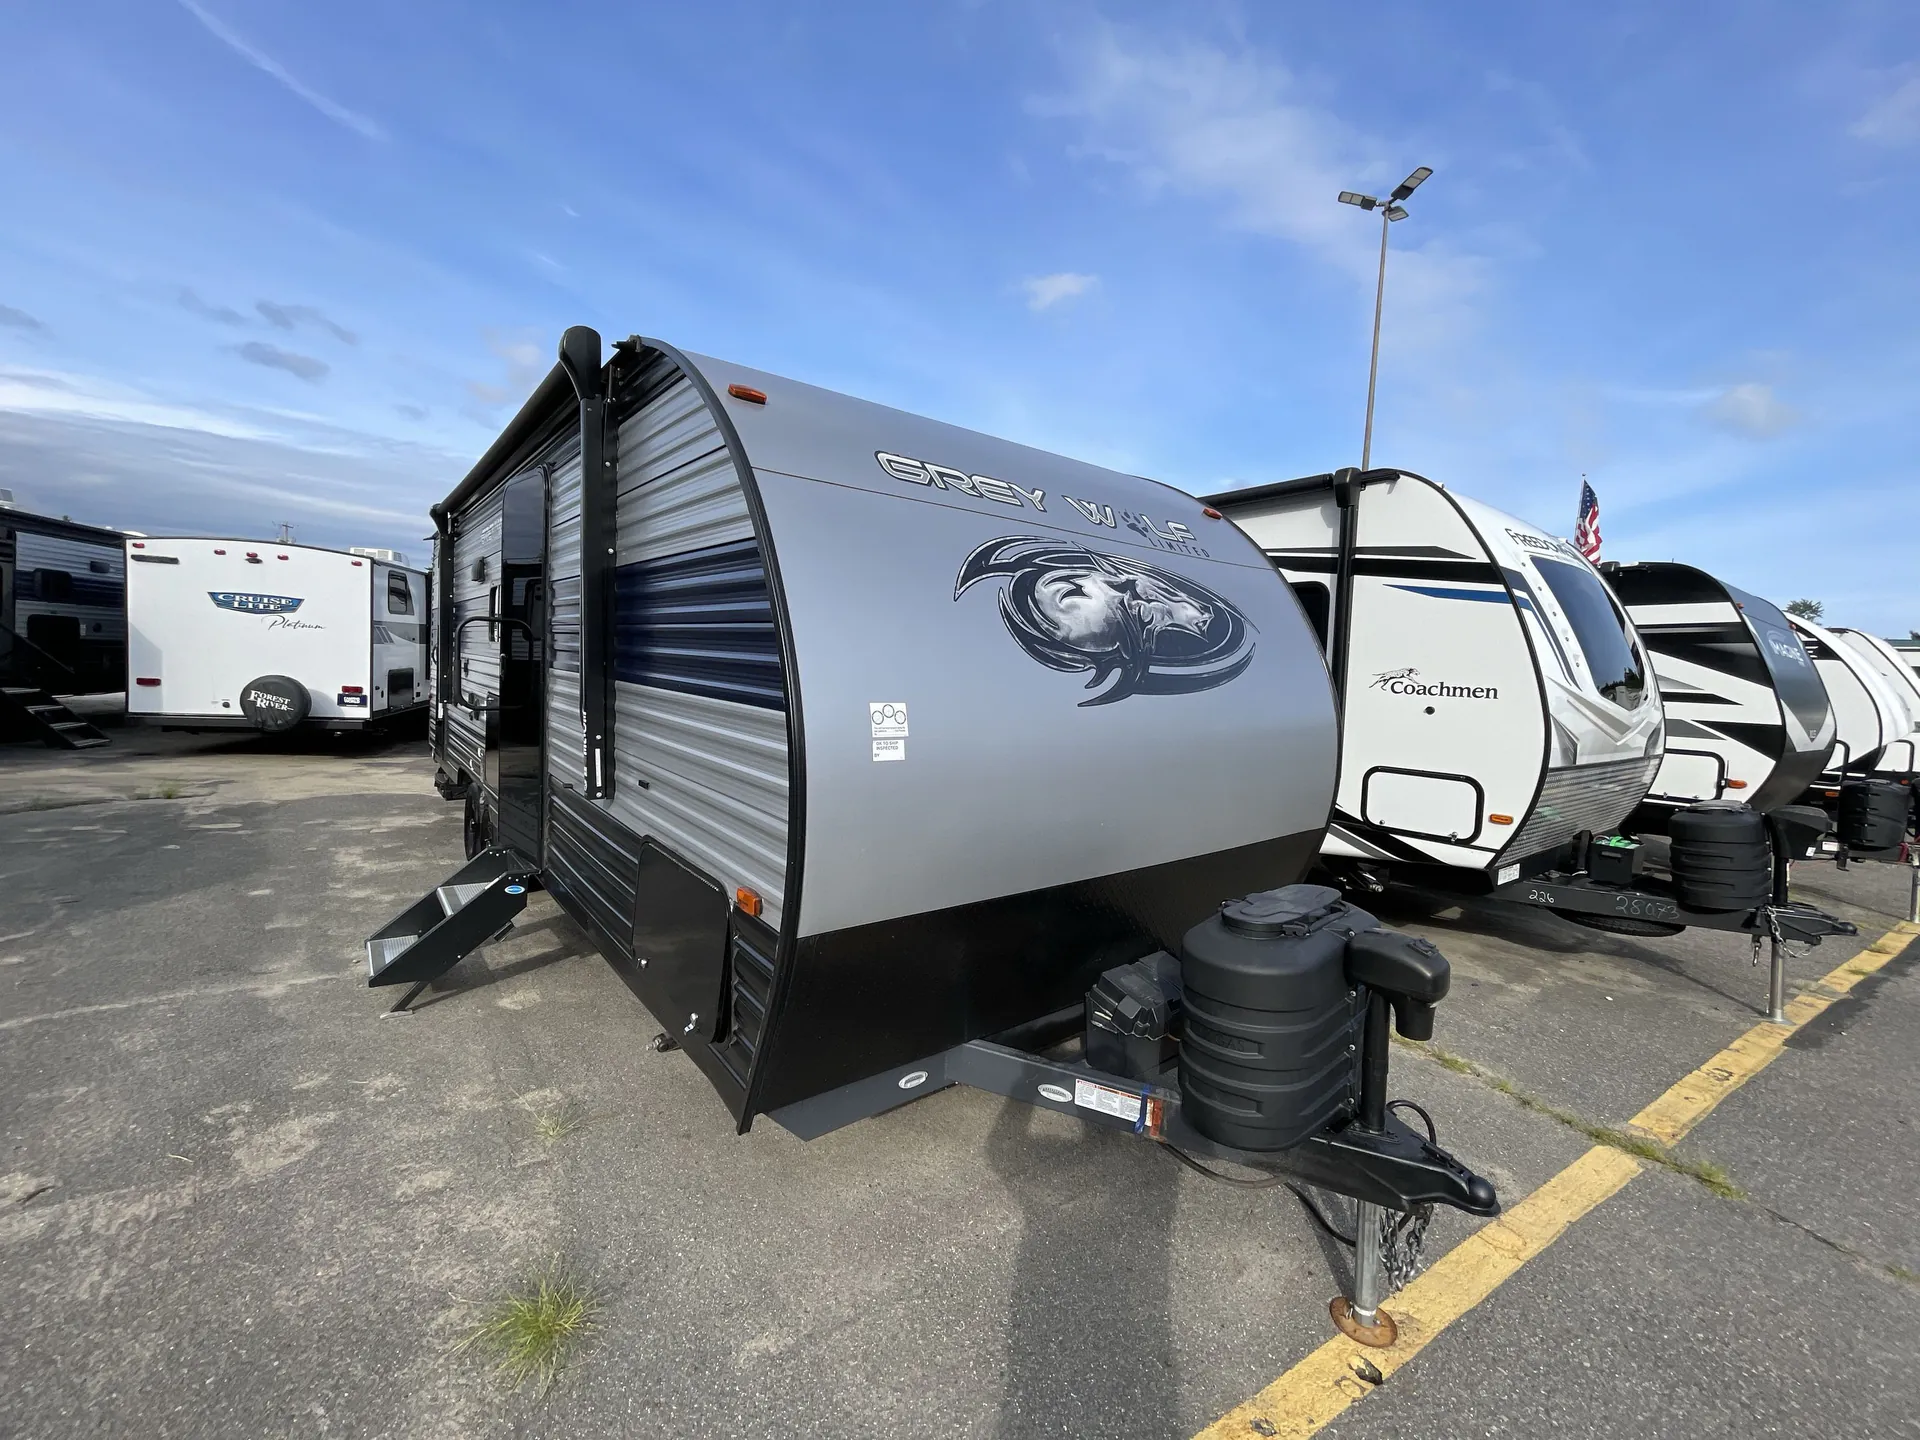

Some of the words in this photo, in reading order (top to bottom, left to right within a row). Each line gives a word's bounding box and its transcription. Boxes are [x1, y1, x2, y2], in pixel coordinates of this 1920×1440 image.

[874, 450, 1047, 513] GREY
[1148, 537, 1210, 558] LIMITED
[218, 594, 293, 605] CRUISE
[233, 601, 282, 610] LITE
[261, 615, 326, 631] Platinum
[247, 690, 290, 705] FOREST
[1390, 681, 1498, 699] Coachmen
[256, 698, 294, 711] RIVER
[1529, 889, 1555, 903] 226
[1616, 896, 1680, 920] 28073
